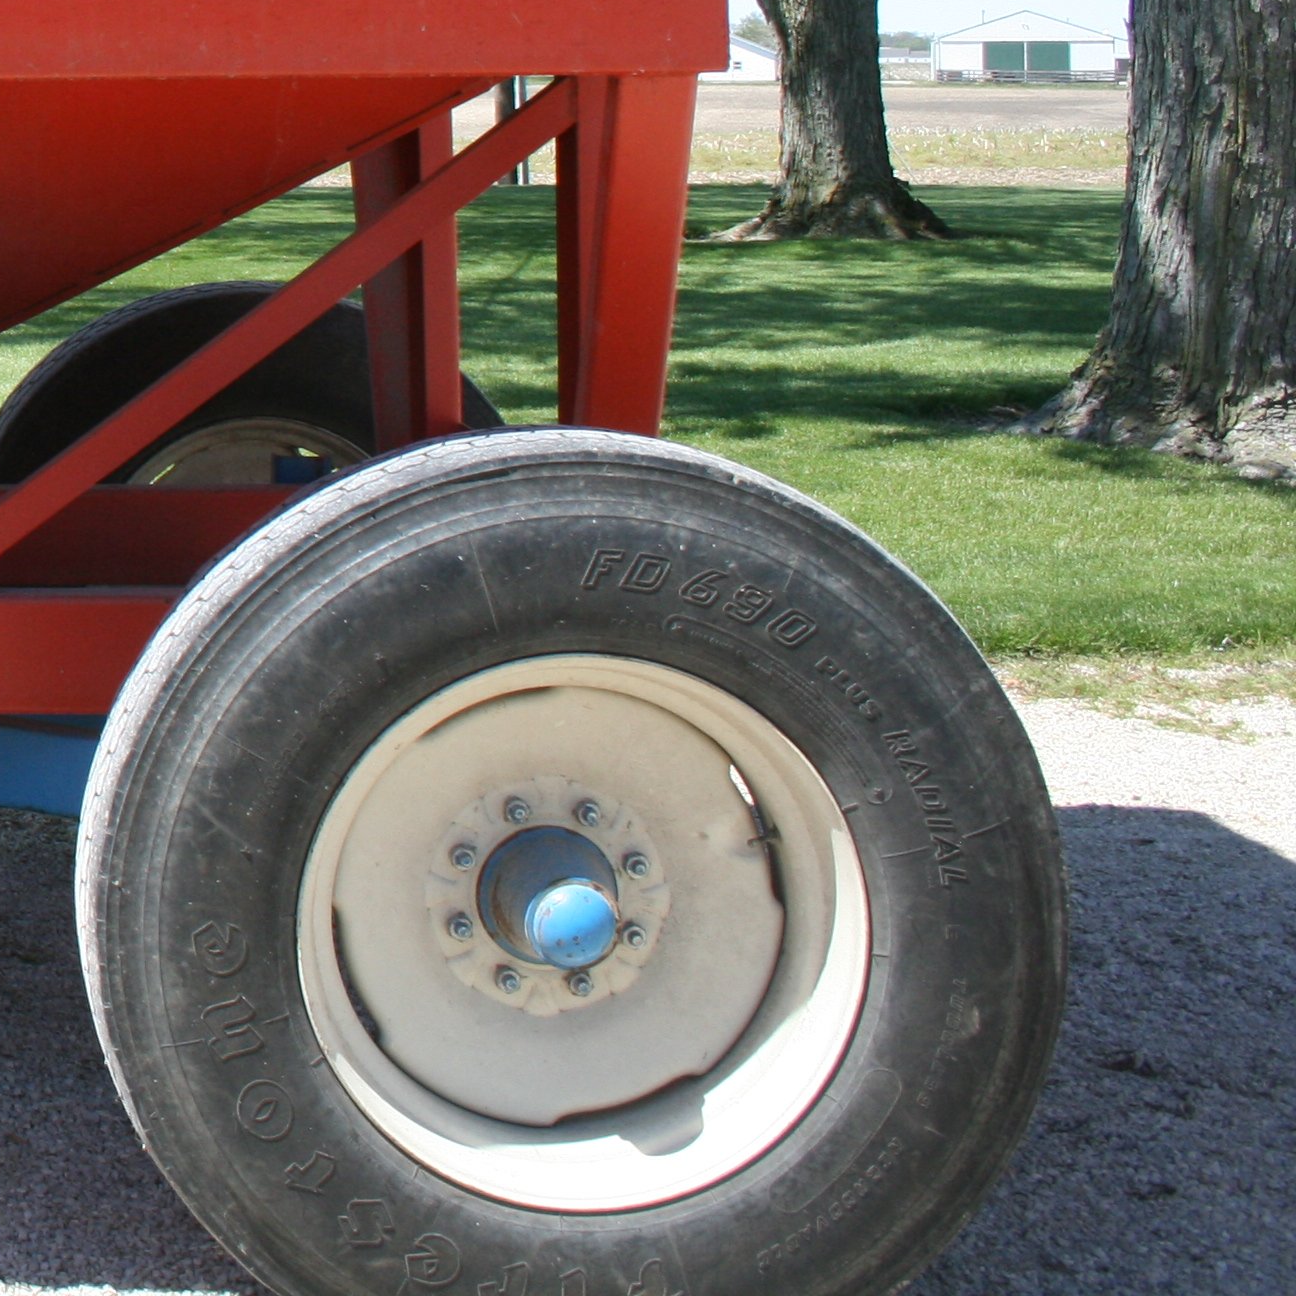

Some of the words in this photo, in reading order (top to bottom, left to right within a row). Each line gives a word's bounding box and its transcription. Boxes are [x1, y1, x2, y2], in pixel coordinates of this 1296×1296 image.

[580, 548, 672, 593] FD
[678, 568, 817, 646] 690
[814, 655, 883, 722] PLUS
[880, 729, 969, 890] RADIAL
